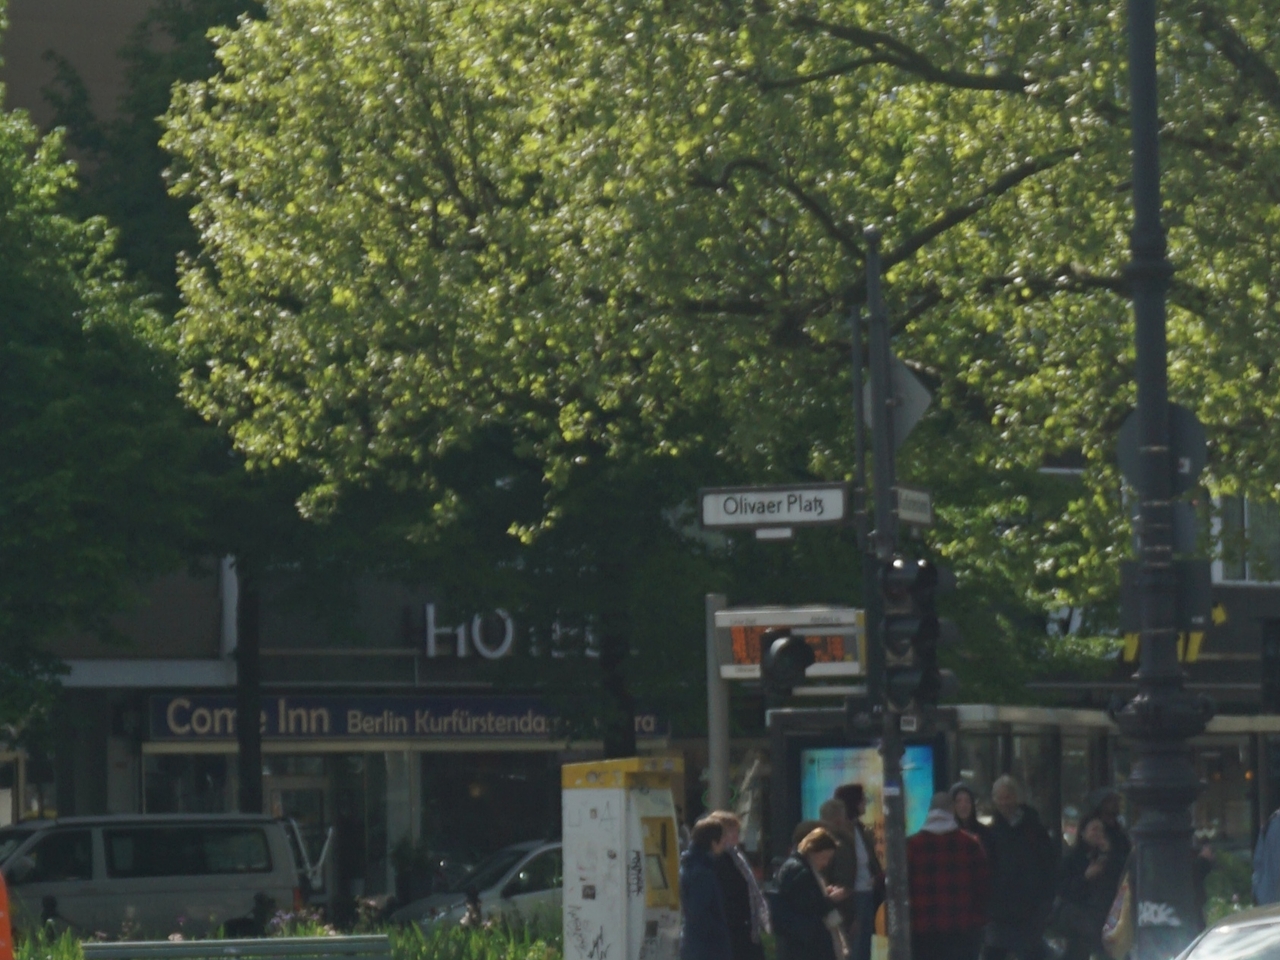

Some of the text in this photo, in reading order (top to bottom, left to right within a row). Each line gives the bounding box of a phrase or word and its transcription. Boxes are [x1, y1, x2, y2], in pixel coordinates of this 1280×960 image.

[723, 493, 825, 517] Olivaer Platz
[278, 699, 330, 734] Inn
[347, 709, 408, 733] Berlin
